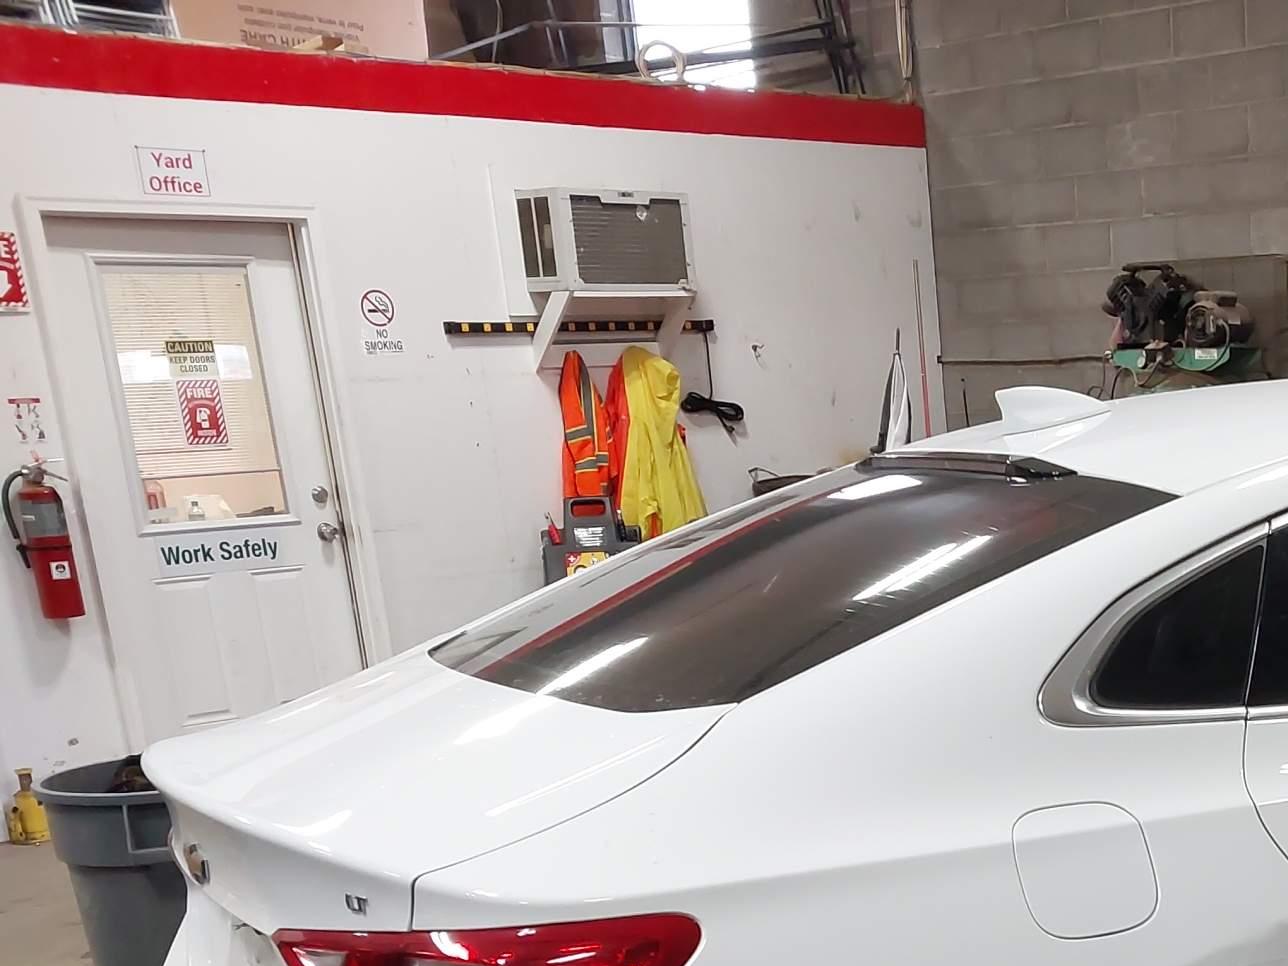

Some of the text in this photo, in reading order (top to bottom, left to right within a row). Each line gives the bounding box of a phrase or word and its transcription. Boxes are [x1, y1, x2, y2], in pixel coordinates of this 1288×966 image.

[150, 152, 193, 169] Yard
[149, 175, 204, 194] Office
[375, 328, 389, 340] NO
[167, 341, 214, 353] CAUTION
[364, 340, 403, 351] SMOKING
[169, 354, 216, 364] KEEP DOORS
[180, 364, 209, 373] CLOSED
[185, 387, 213, 399] FIRE
[160, 538, 278, 566] Work Safely
[345, 893, 368, 916] LT
